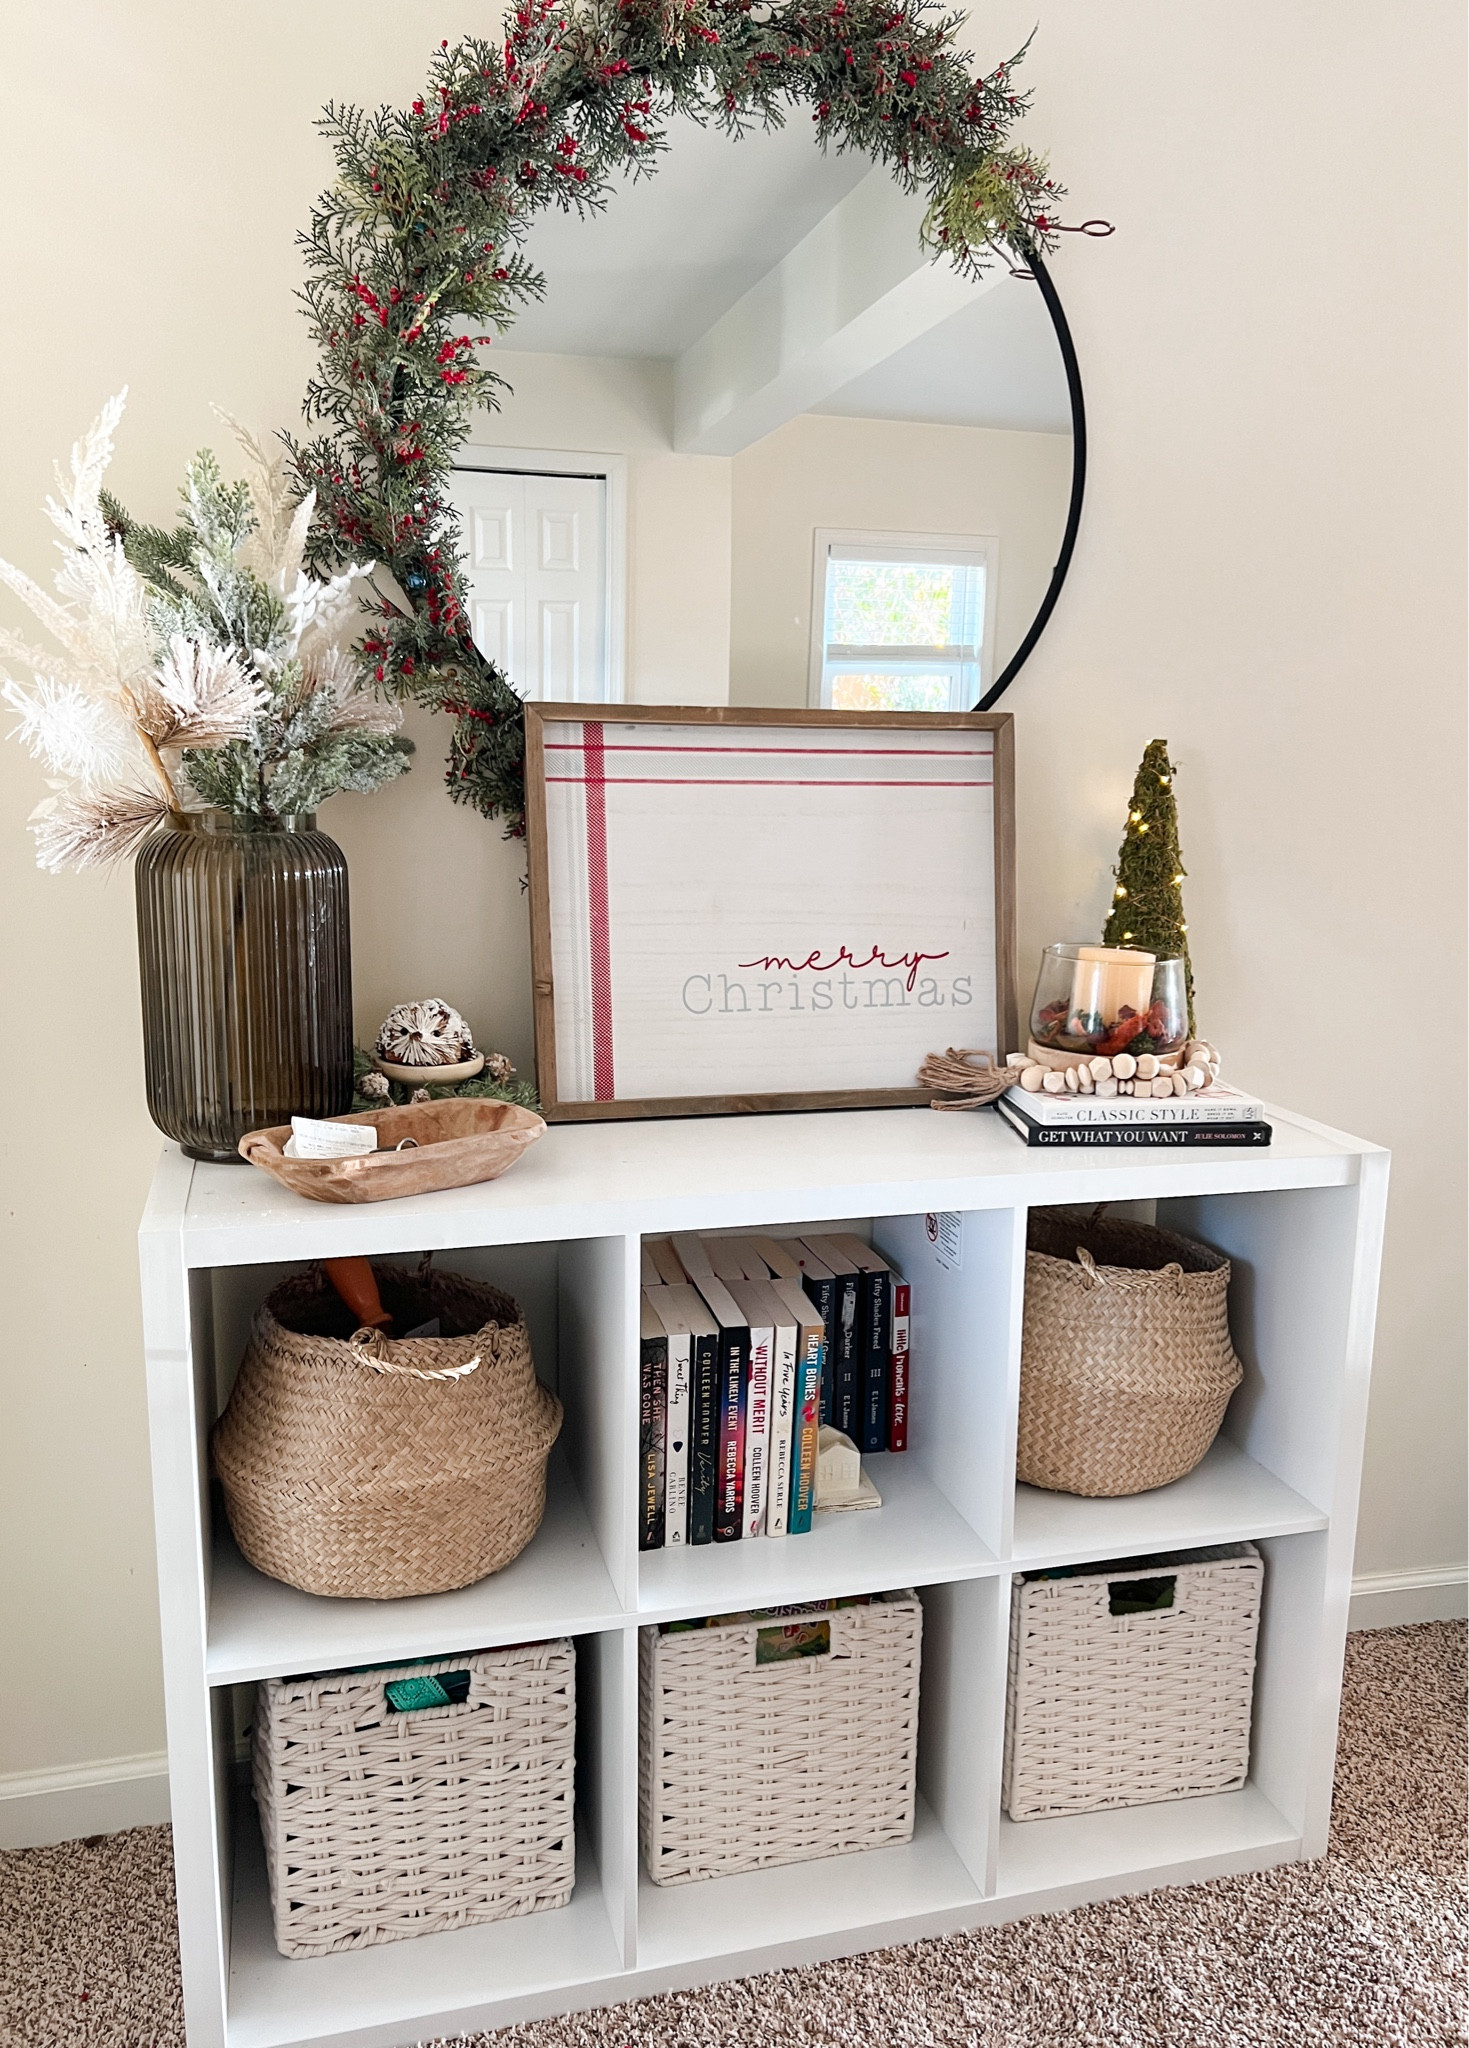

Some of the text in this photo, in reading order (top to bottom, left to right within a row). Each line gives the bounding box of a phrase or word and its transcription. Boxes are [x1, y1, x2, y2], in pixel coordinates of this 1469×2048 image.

[738, 945, 949, 991] merry
[682, 972, 973, 1014] Christmas
[1038, 1130, 1189, 1143] GET WHAT YOU WANT
[1076, 1109, 1146, 1121] CLASSIC
[1149, 1108, 1200, 1121] STYLE
[820, 1285, 830, 1303] Fifty
[872, 1278, 882, 1350] Fifty Shades Freed
[823, 1335, 830, 1344] of
[844, 1331, 853, 1359] Darker
[896, 1329, 906, 1351] little
[670, 1358, 689, 1405] Sweet Thing
[728, 1346, 740, 1431] IN THE LIKELY EVENT
[752, 1345, 768, 1434] WITHOUT MERIT
[778, 1351, 794, 1417] In Five Years
[804, 1334, 820, 1401] HEART BONES
[843, 1372, 851, 1382] II
[870, 1368, 881, 1378] III
[642, 1364, 652, 1425] WAS GONE
[652, 1364, 662, 1422] THEN SHE
[701, 1352, 711, 1445] COLLEEN HOOVER
[842, 1407, 851, 1429] James
[647, 1454, 656, 1525] LISA JEWELL
[668, 1472, 677, 1514] CARLINO
[695, 1452, 712, 1495] Verity
[725, 1441, 737, 1513] REBECCA YARROS
[751, 1447, 763, 1515] COLLEEN HOOVER
[776, 1440, 786, 1509] REBECCA SERLE
[798, 1428, 813, 1511] COLLEEN HOOVER
